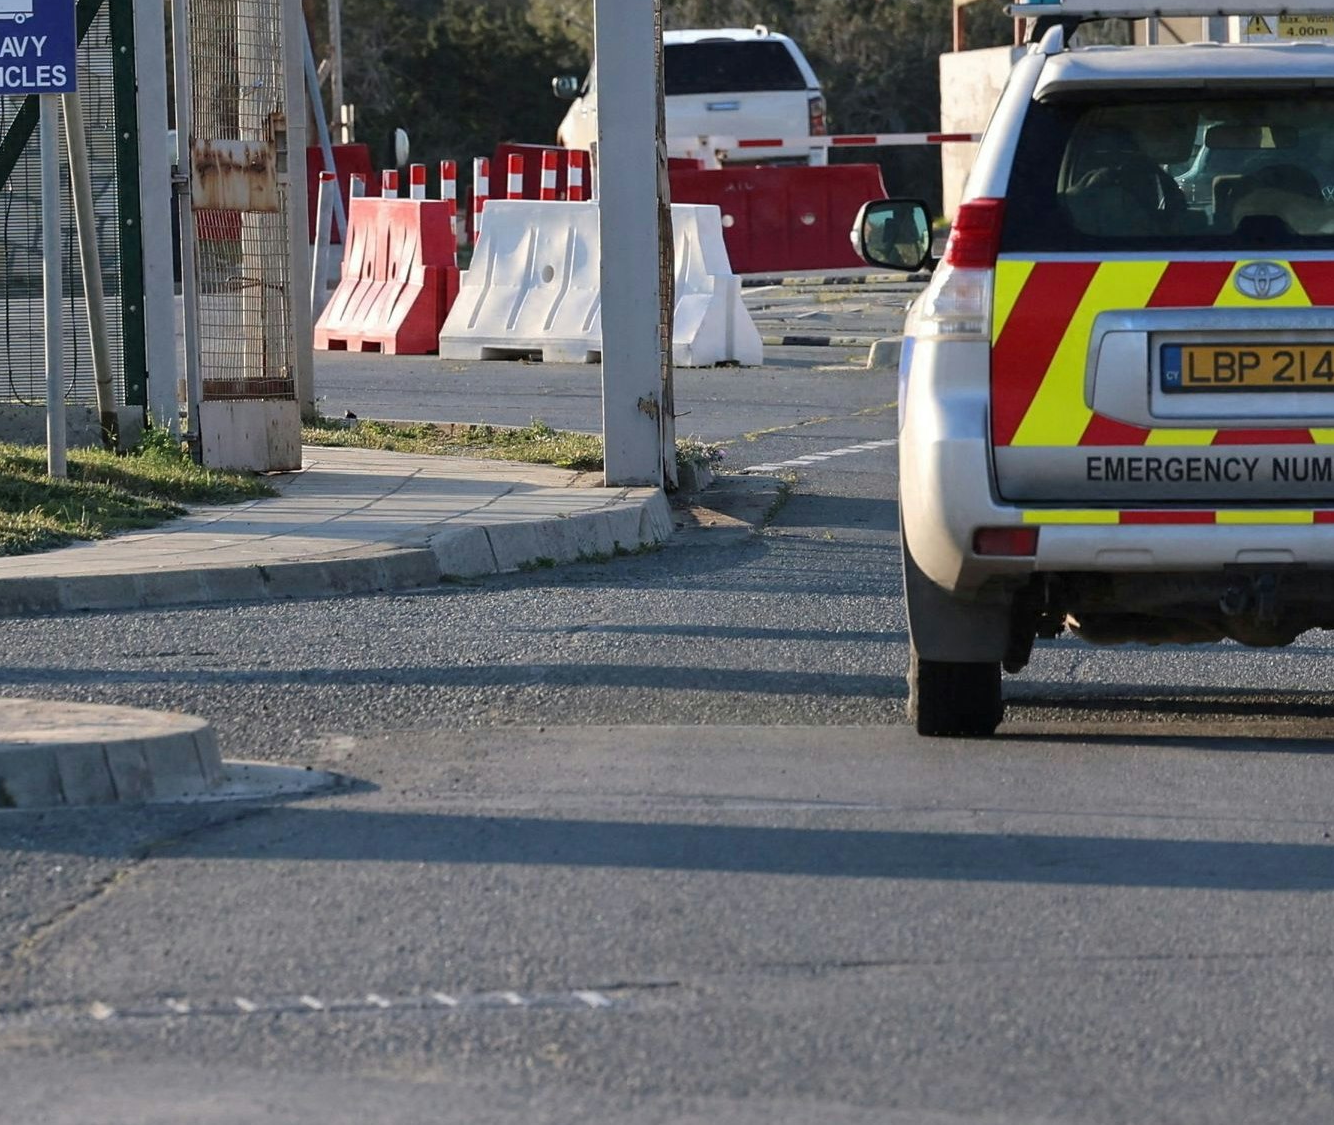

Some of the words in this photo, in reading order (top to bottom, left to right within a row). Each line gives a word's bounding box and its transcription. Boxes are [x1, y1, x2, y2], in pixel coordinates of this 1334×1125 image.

[1287, 27, 1328, 36] 4.00m
[1188, 351, 1260, 383] LBP
[1272, 350, 1334, 382] 214
[1086, 456, 1259, 482] EMERGENCY
